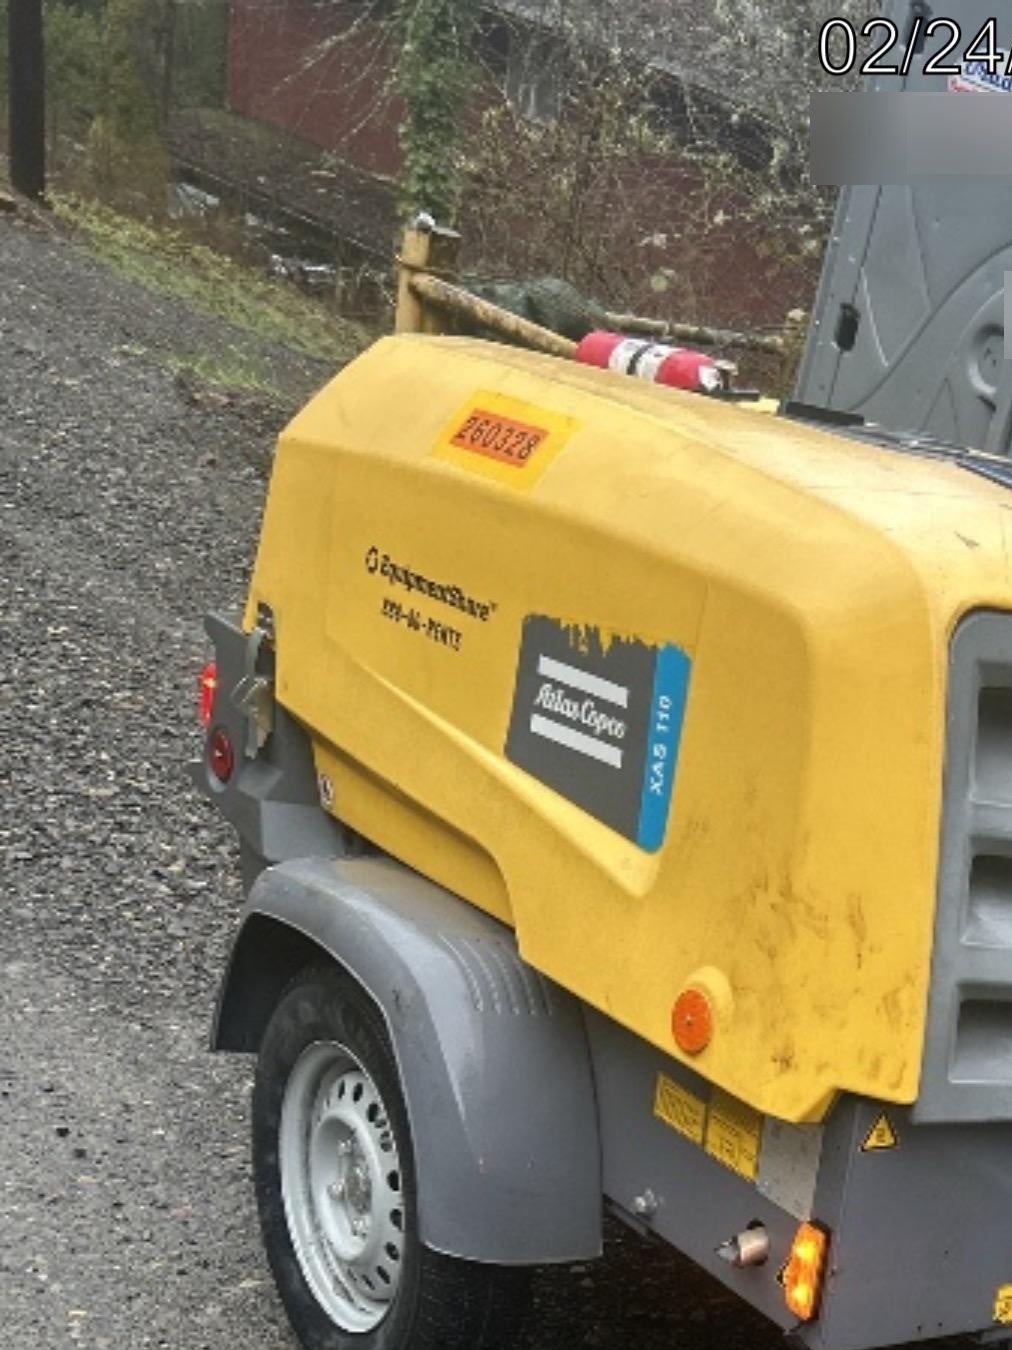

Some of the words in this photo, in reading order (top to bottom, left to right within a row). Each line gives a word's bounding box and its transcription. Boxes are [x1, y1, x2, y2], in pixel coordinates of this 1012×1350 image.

[453, 415, 541, 461] 260328
[535, 683, 581, 721] Atlas
[580, 699, 627, 738] Copco
[656, 695, 673, 733] 110
[650, 743, 667, 796] XAS
